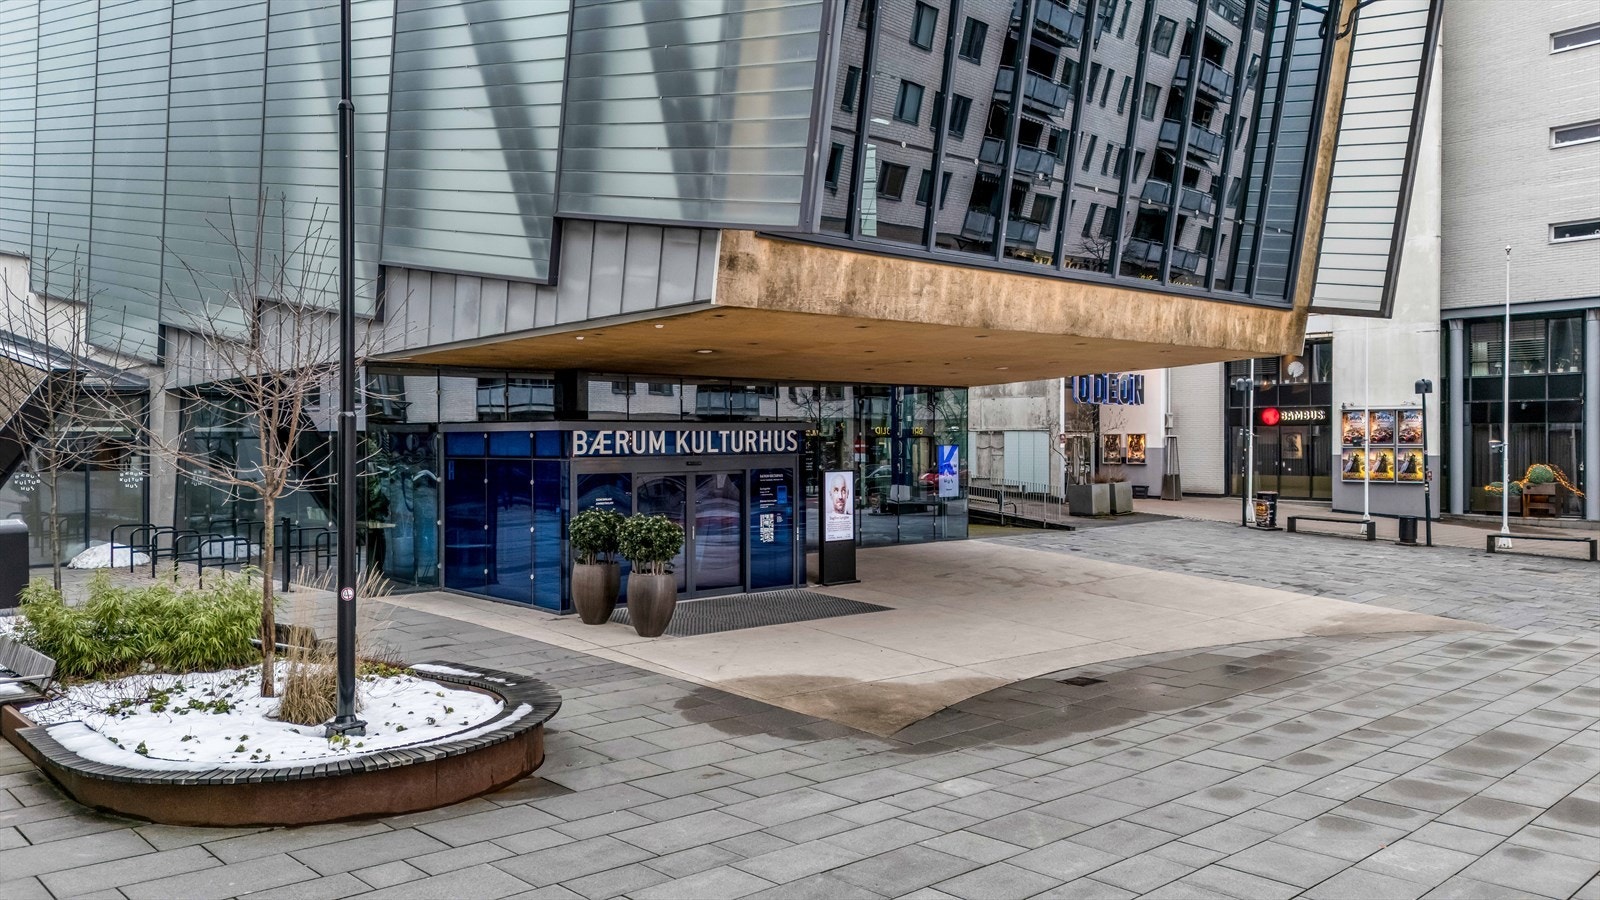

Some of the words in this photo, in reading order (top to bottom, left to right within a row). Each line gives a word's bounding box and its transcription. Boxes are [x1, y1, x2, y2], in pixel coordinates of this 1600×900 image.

[1072, 372, 1145, 405] ODEON
[1280, 409, 1326, 421] BAMBUS
[573, 430, 665, 455] BÆRUM
[676, 430, 798, 454] KULTURHUS
